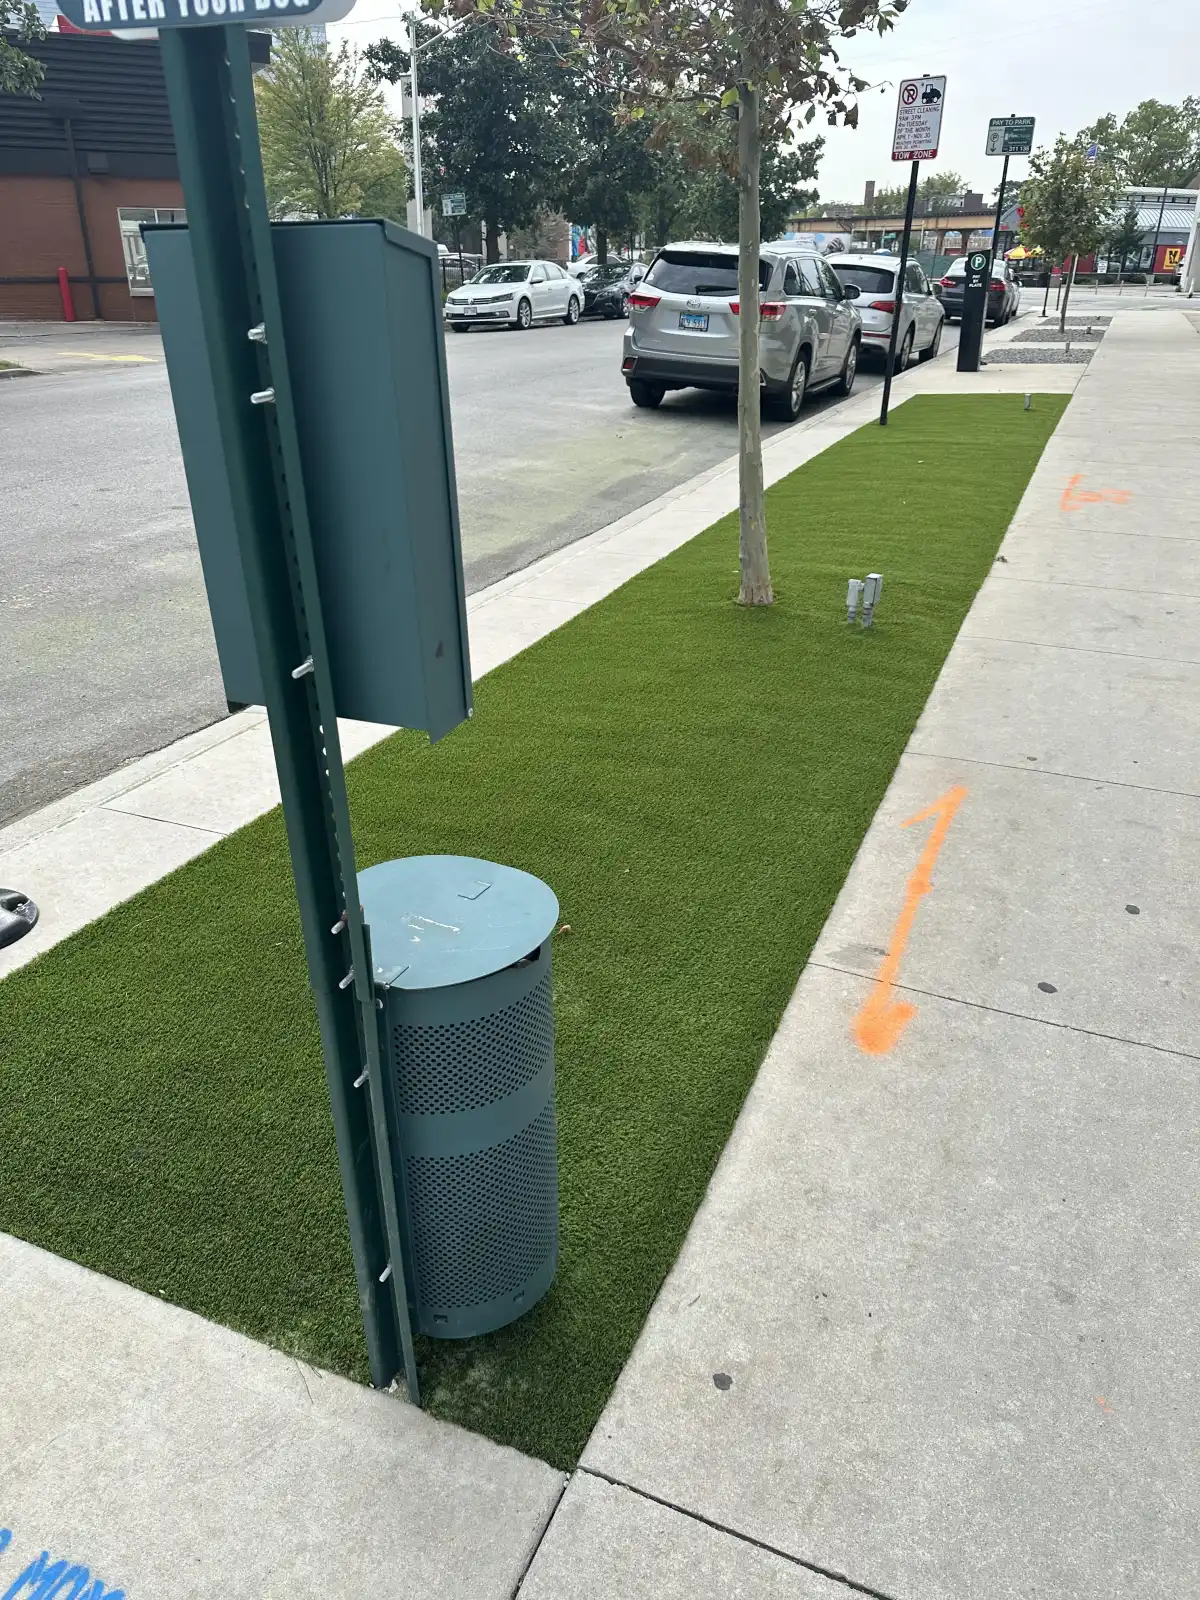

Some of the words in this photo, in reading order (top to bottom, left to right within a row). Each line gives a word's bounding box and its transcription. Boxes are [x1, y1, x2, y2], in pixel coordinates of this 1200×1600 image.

[83, 0, 166, 23] AFTER
[895, 151, 911, 160] TOW
[912, 150, 934, 159] ZONE
